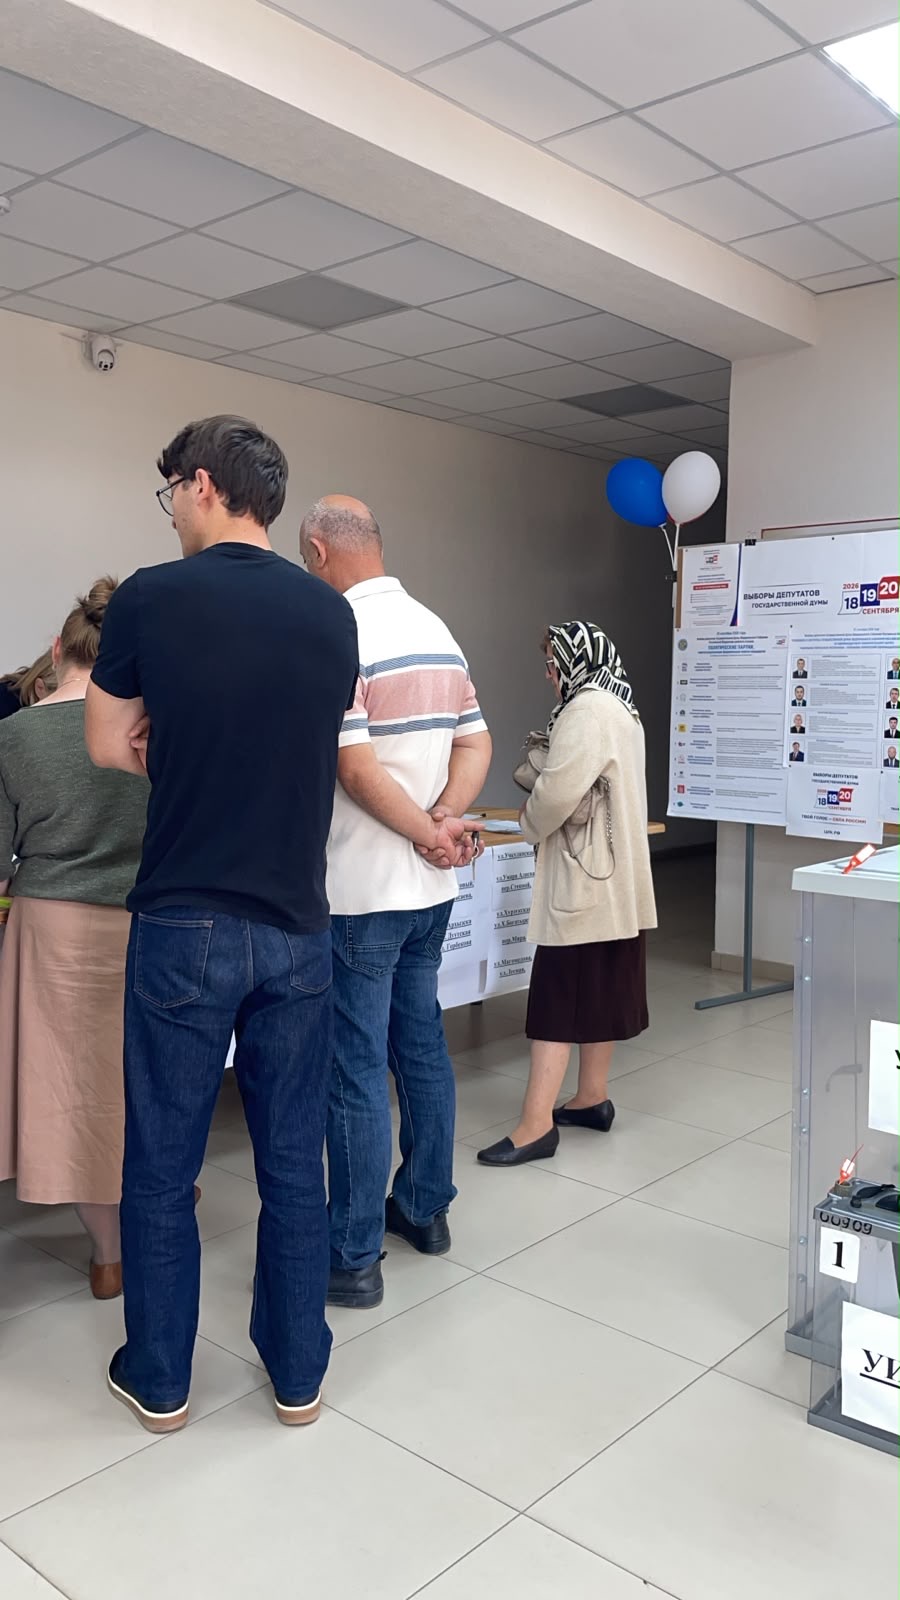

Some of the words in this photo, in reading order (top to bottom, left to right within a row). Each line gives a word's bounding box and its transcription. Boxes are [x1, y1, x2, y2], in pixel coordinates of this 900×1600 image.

[743, 592, 775, 600] ВЫБОРЫ
[776, 590, 820, 599] ДЕПУТАТОВ
[844, 597, 859, 610] 18
[862, 588, 877, 603] 19
[879, 581, 898, 595] 20
[752, 600, 809, 609] ГОСУДАРСТВЕННОЙ
[862, 607, 899, 615] СЕНТЯБРЯ
[818, 797, 827, 806] 18
[828, 794, 838, 803] 19
[839, 791, 851, 800] 20
[832, 1241, 846, 1270] 1
